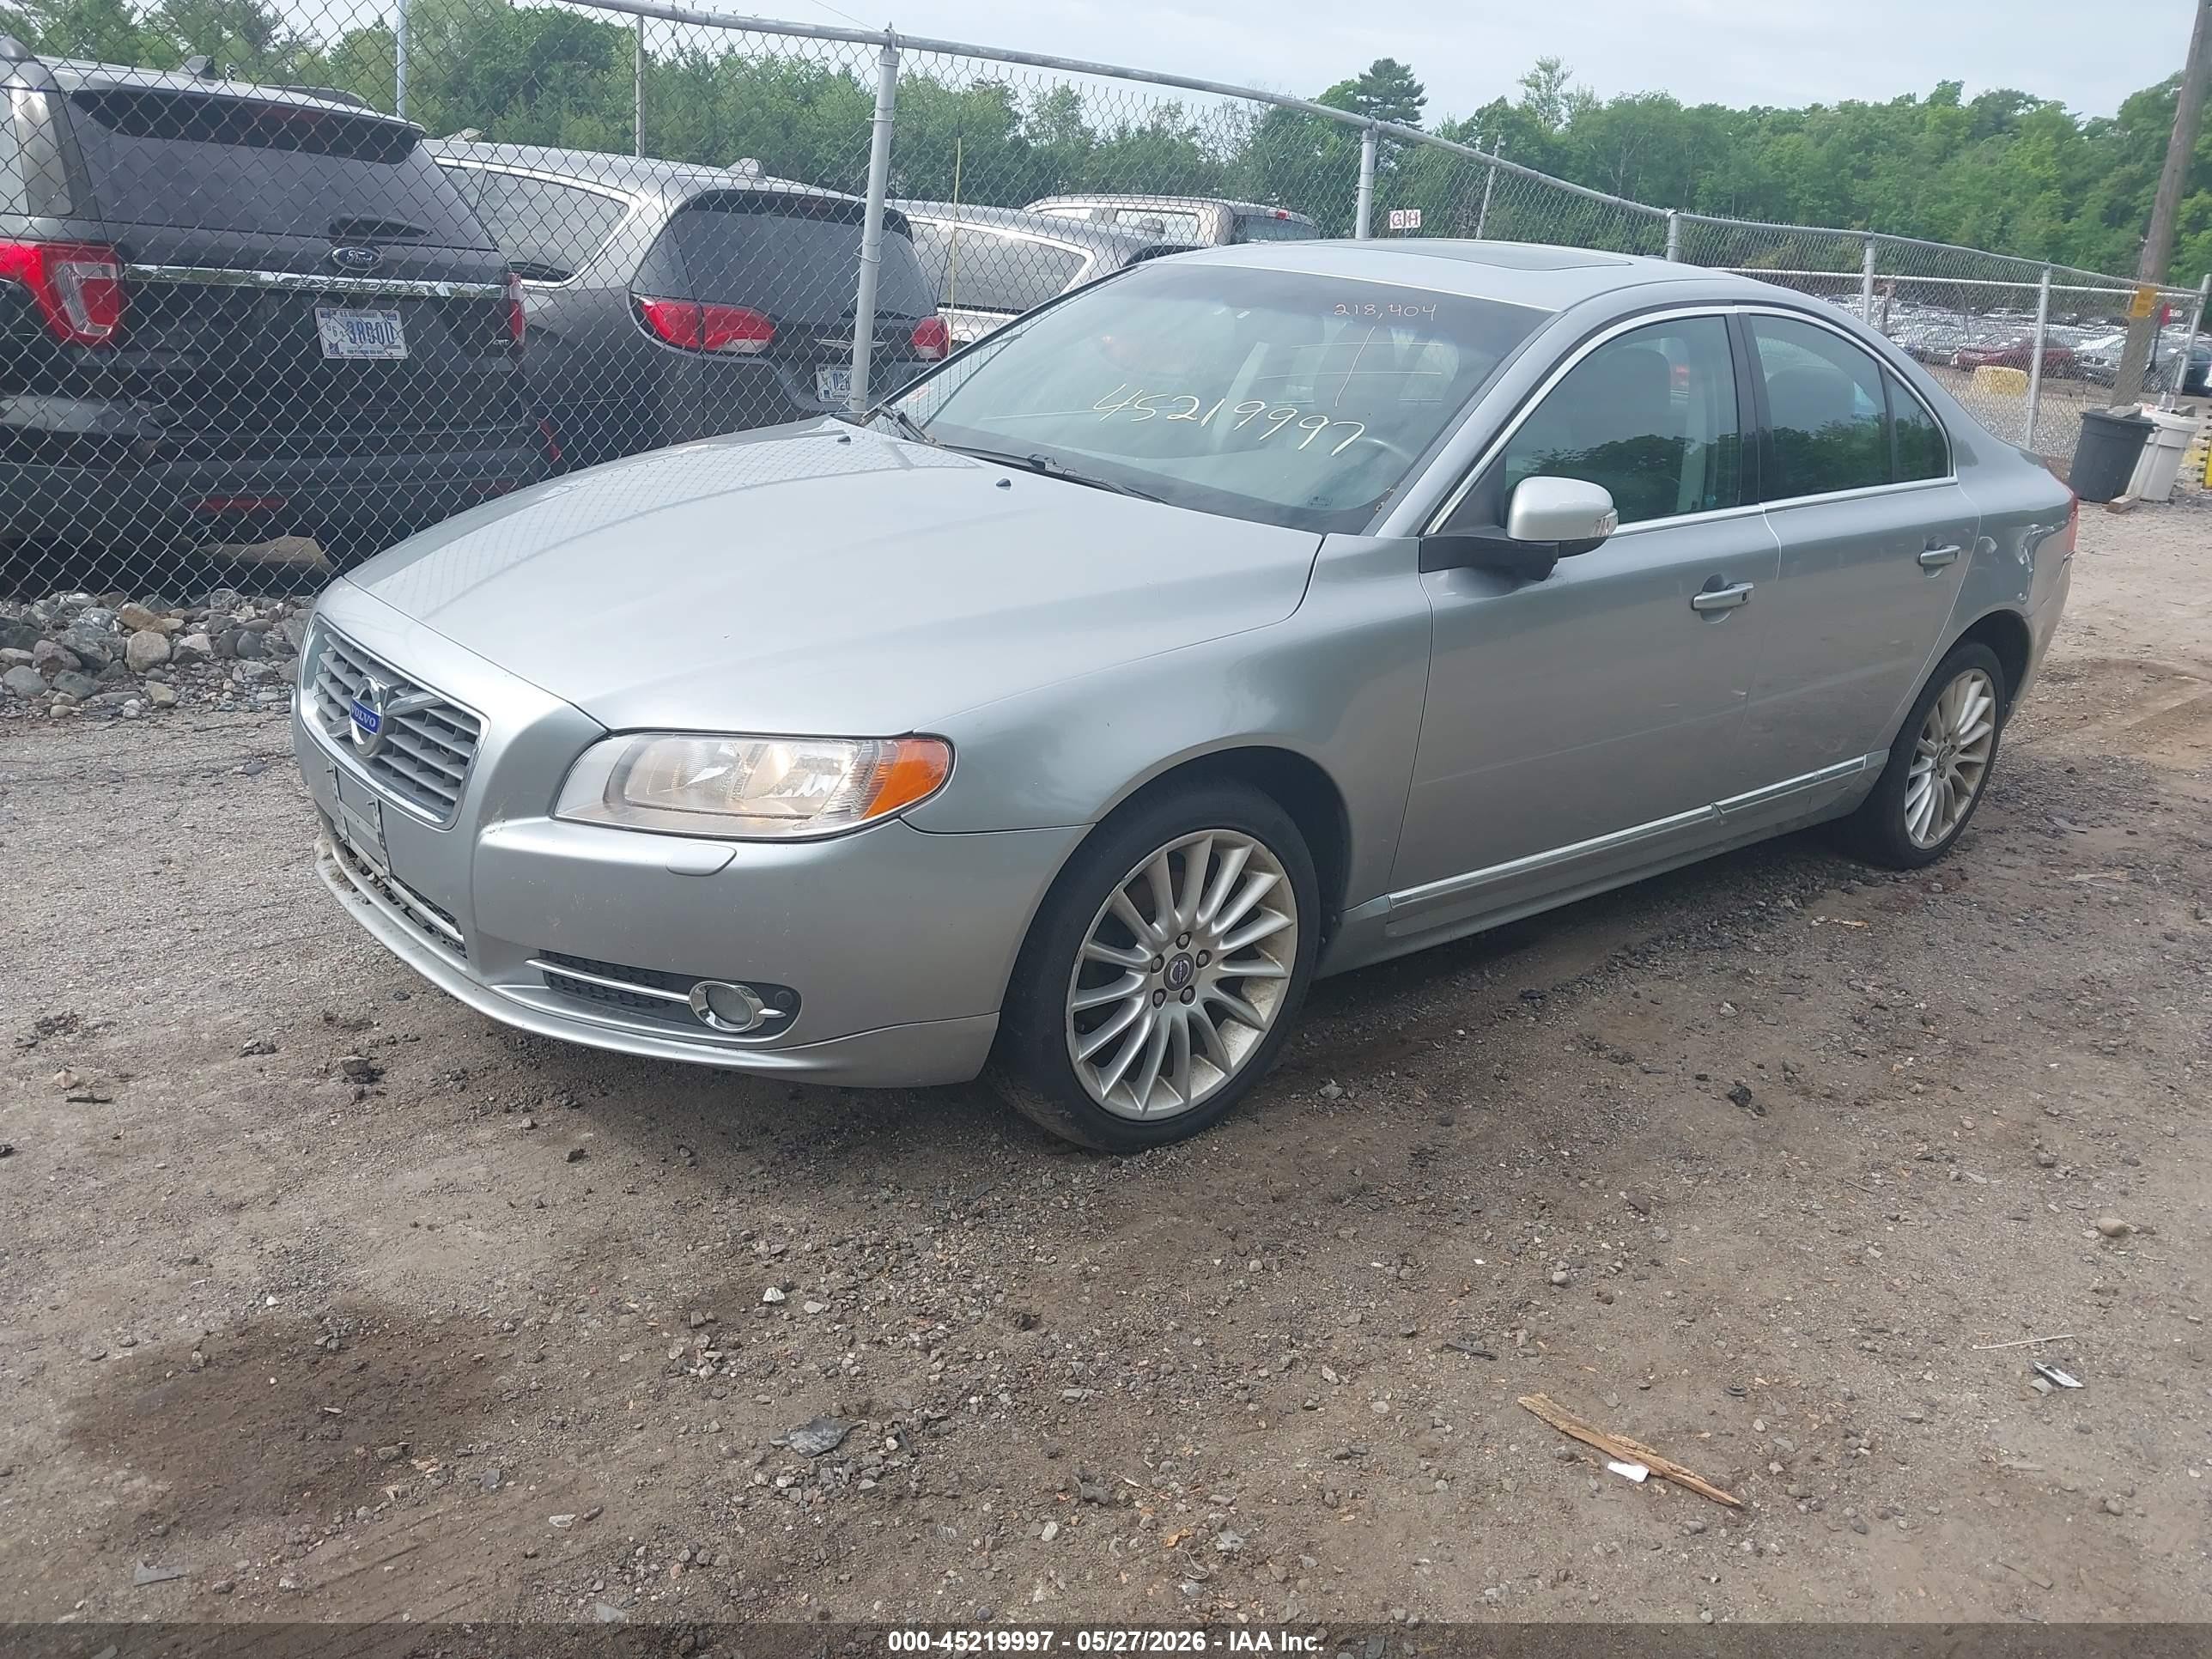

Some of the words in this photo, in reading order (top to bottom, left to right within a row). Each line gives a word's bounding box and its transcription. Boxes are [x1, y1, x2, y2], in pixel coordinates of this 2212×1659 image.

[292, 277, 429, 295] EXPLORER
[1334, 303, 1437, 321] 218,404
[1092, 383, 1365, 457] 45219997
[351, 702, 377, 727] VOLVO
